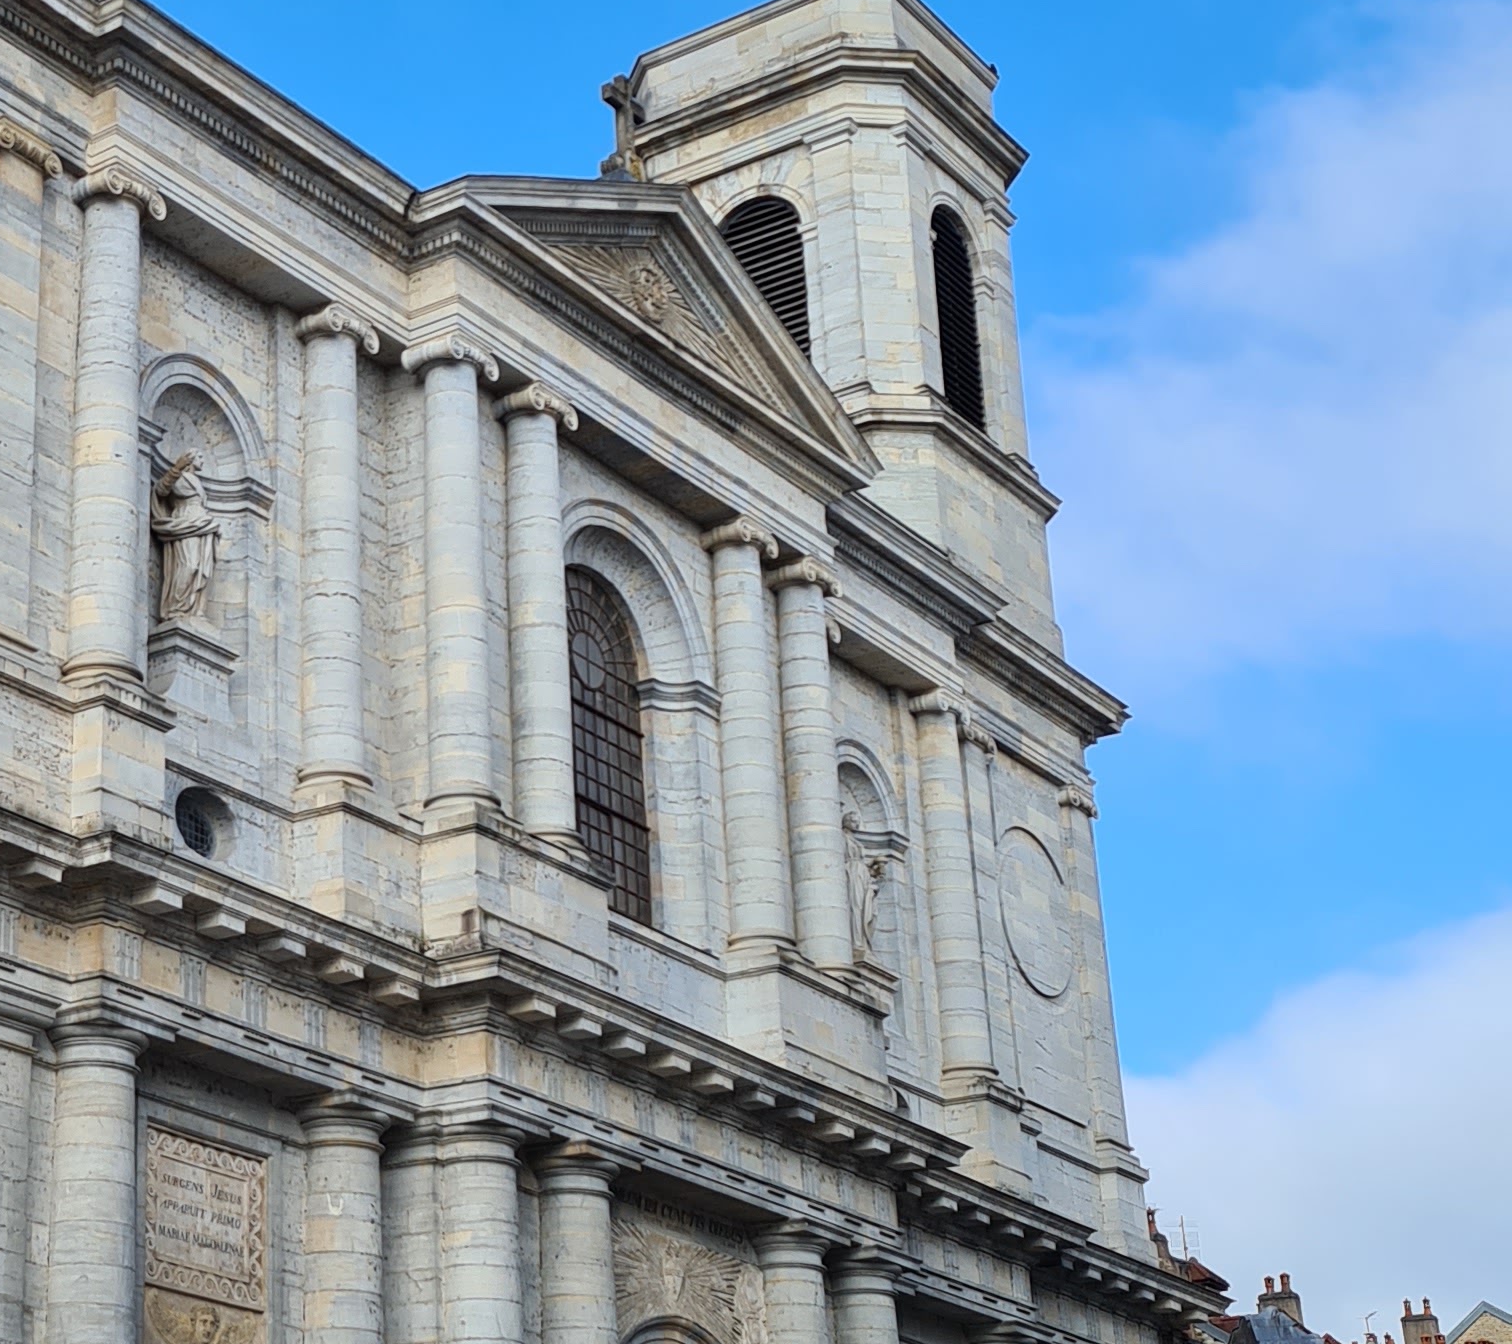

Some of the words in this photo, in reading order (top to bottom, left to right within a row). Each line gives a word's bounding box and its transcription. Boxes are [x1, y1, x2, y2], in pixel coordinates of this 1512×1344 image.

[161, 1173, 204, 1194] SURGENS
[210, 1184, 242, 1205] JESUS
[160, 1199, 206, 1219] APPARUIT
[210, 1211, 241, 1230] PRIMO
[159, 1224, 190, 1243] MARIAE
